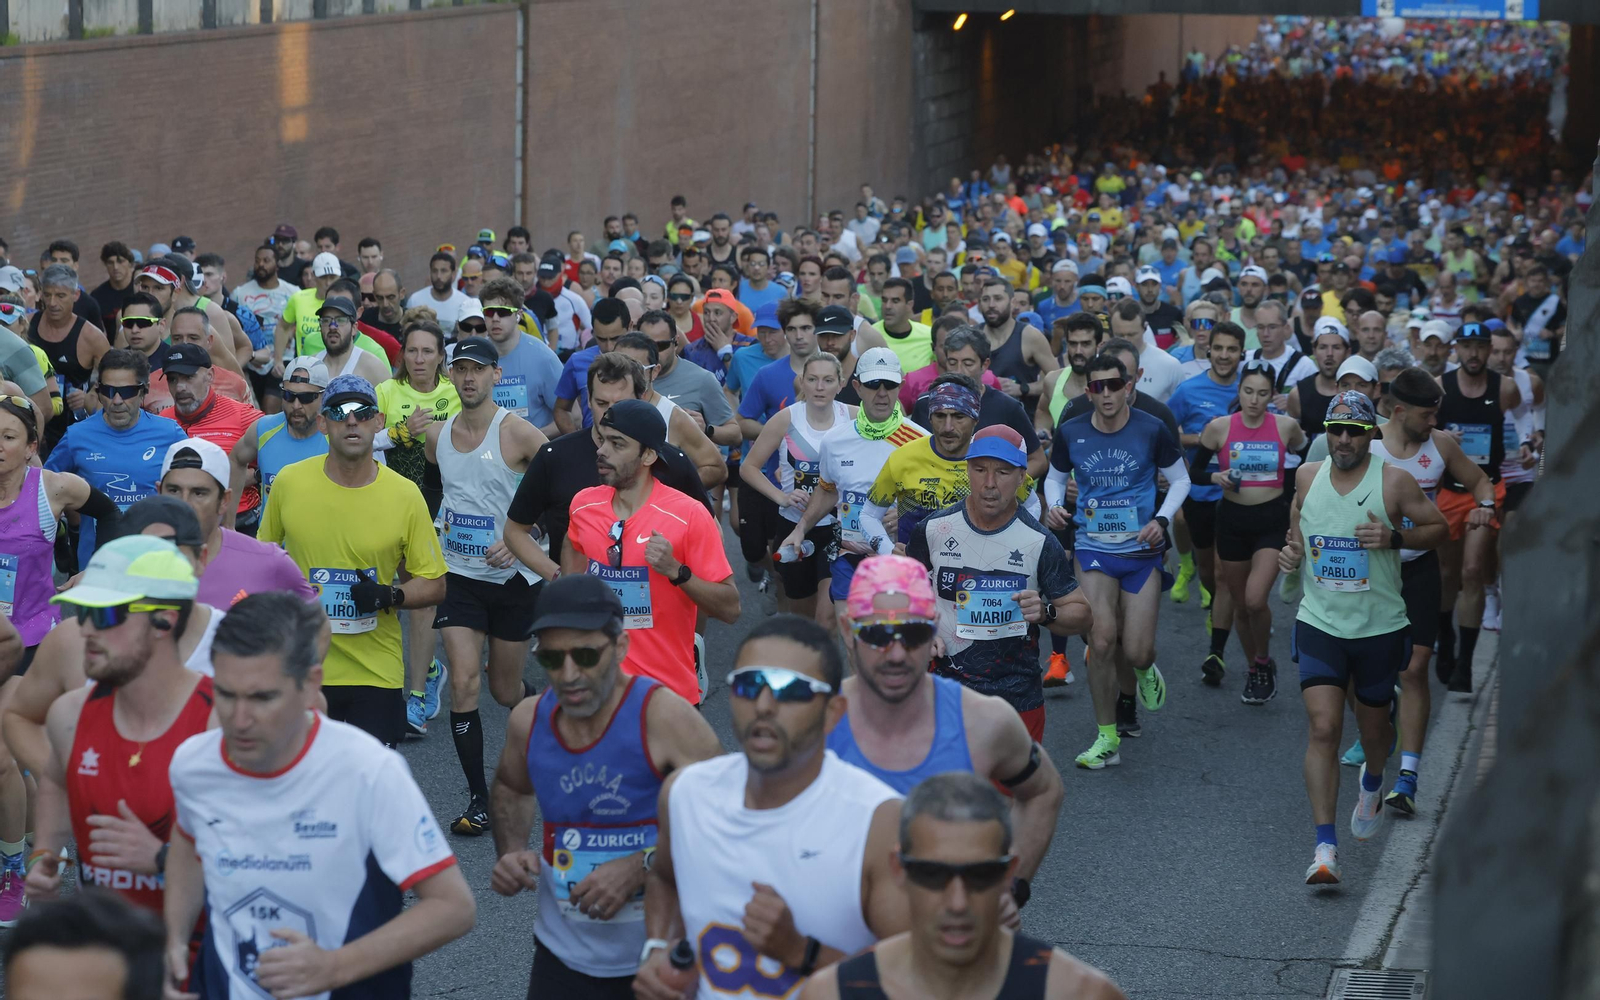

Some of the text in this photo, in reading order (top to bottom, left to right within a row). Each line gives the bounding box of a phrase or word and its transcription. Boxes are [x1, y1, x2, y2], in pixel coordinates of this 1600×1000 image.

[1080, 448, 1139, 472] SAINT LAURENT
[1239, 463, 1269, 471] CANDE
[1090, 476, 1129, 487] RUNNING
[114, 494, 147, 503] ZURICH
[1101, 499, 1130, 507] ZURICH
[456, 517, 487, 527] ZURICH
[1098, 522, 1127, 532] BORIS
[457, 532, 473, 541] 6992
[1328, 540, 1360, 549] ZURICH
[1329, 556, 1346, 564] 4827
[602, 569, 640, 578] ZURICH
[1321, 565, 1356, 578] PABLO
[981, 580, 1019, 588] ZURICH
[335, 592, 352, 601] 715
[982, 599, 1002, 607] 7064
[970, 610, 1012, 624] MARIO
[559, 762, 623, 794] COCAA
[586, 832, 645, 848] ZURICH
[249, 905, 281, 920] 15K
